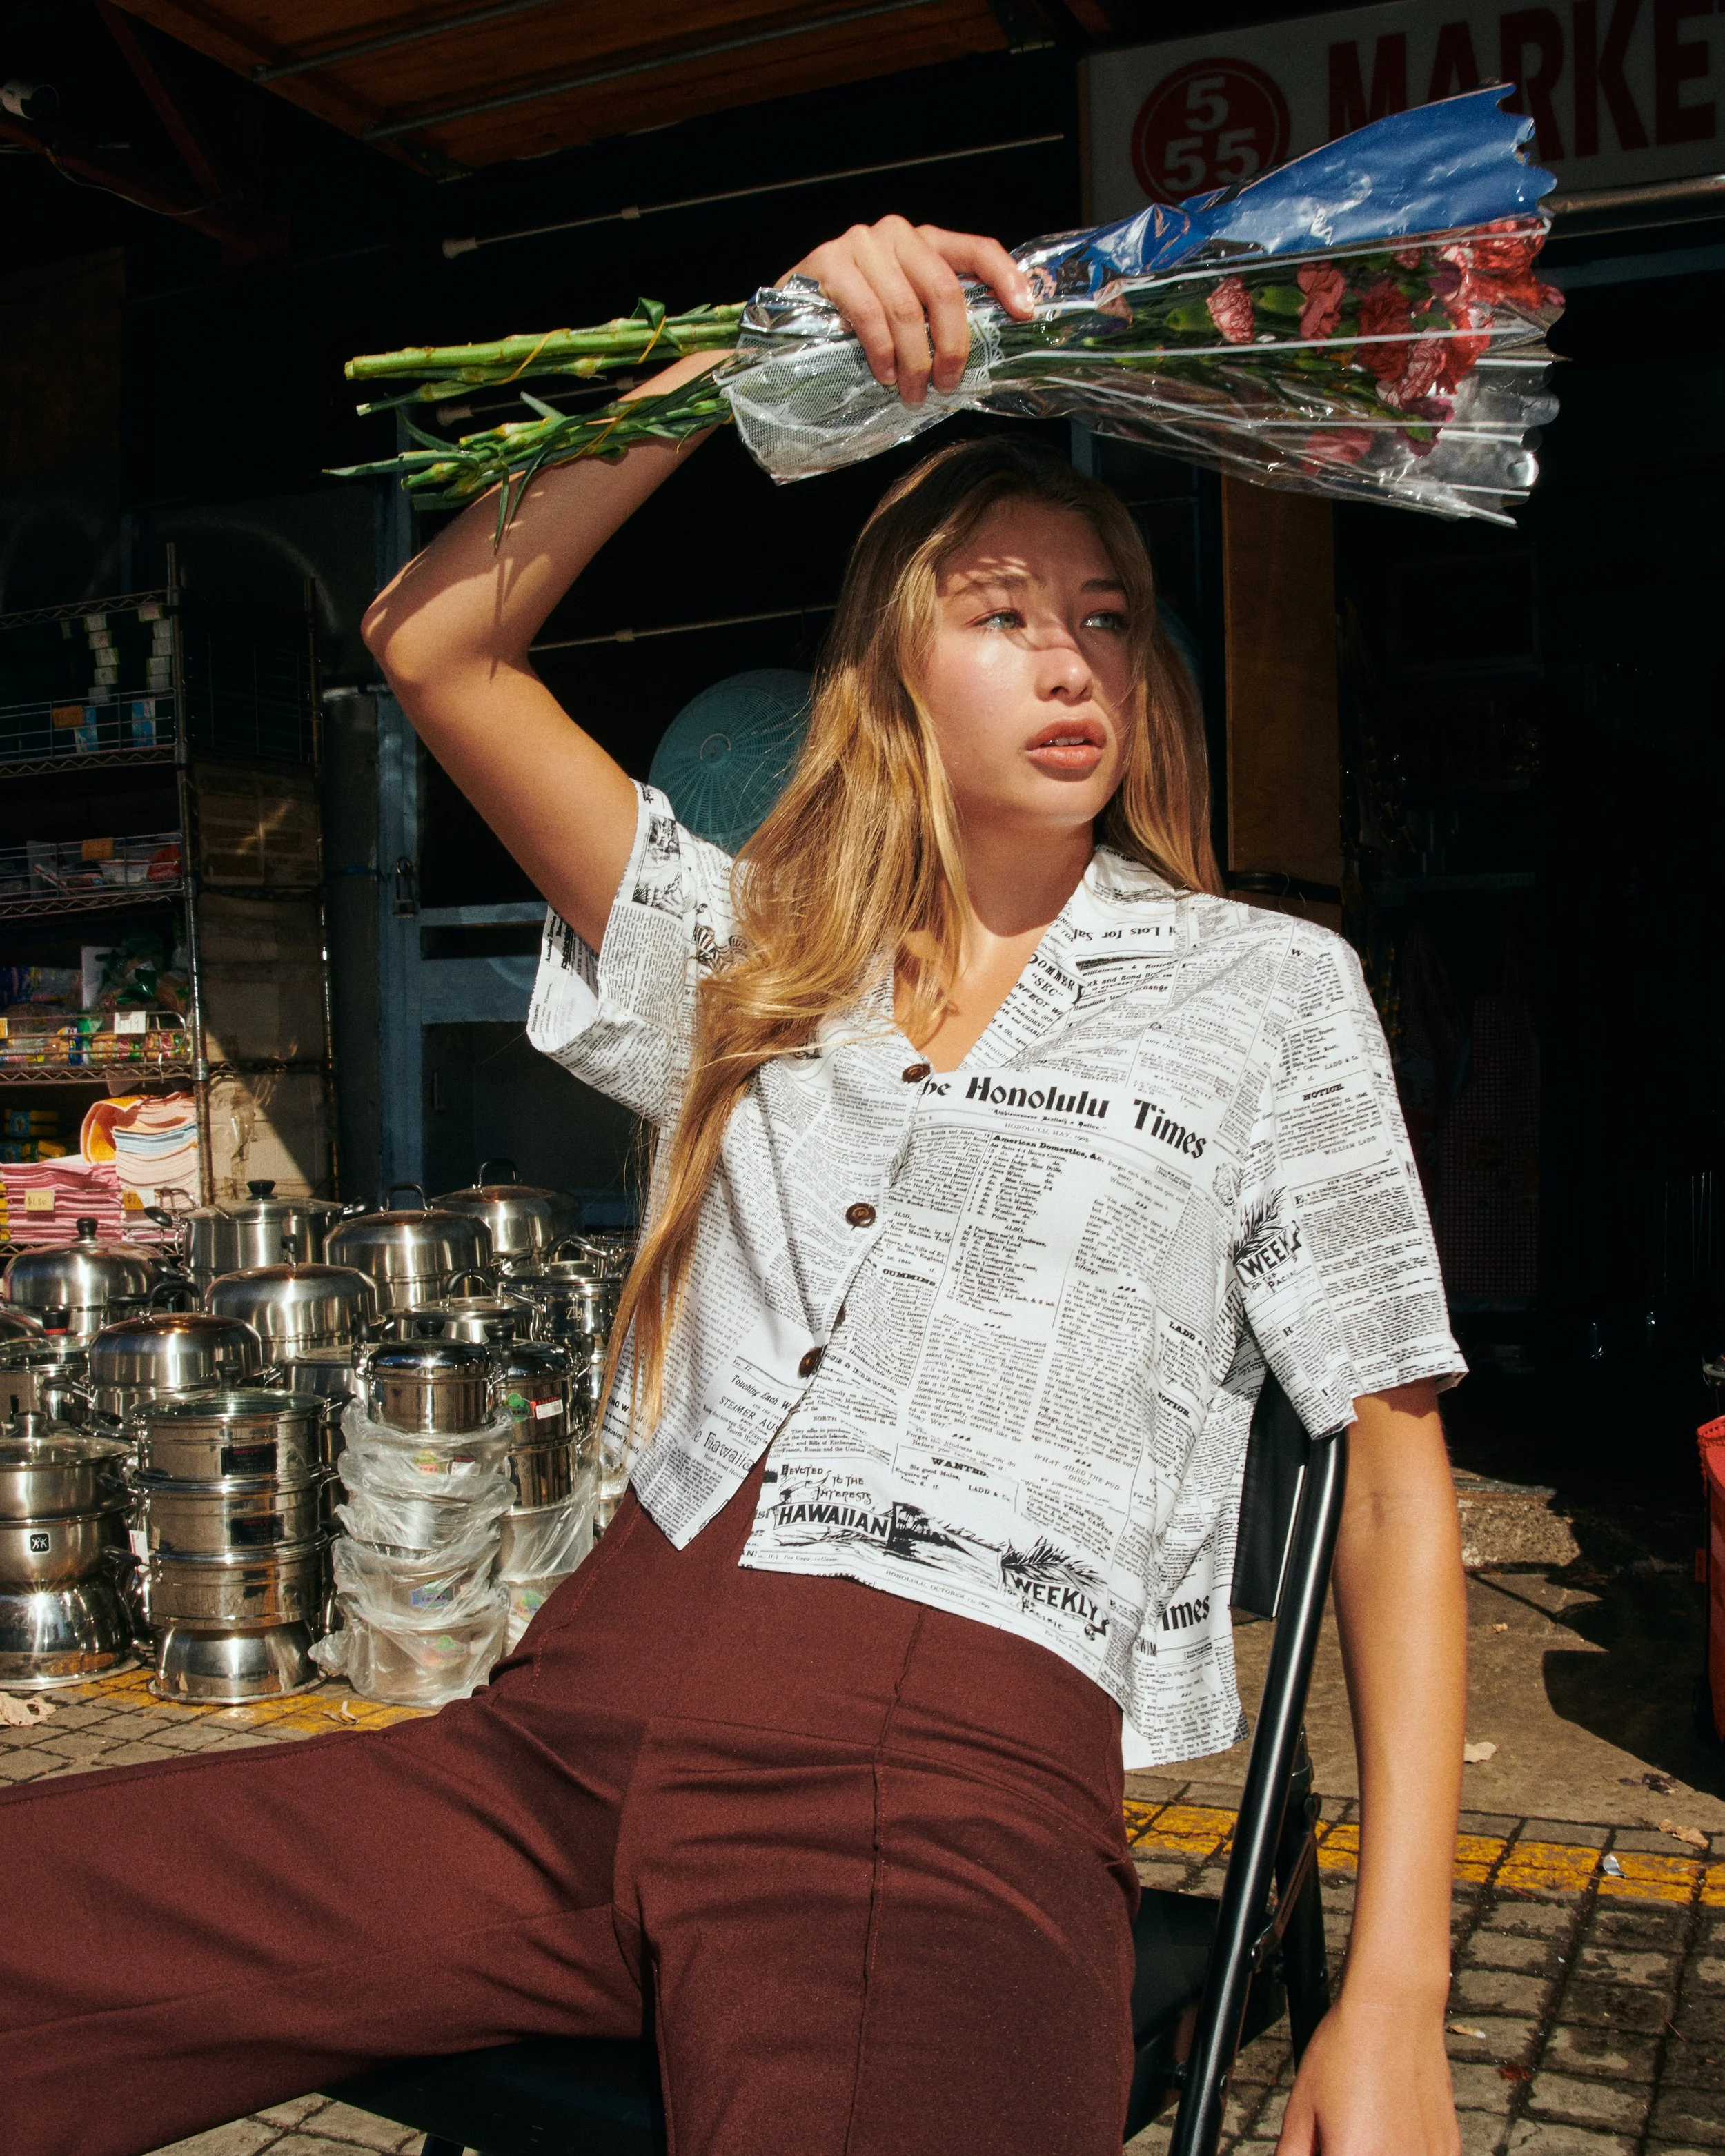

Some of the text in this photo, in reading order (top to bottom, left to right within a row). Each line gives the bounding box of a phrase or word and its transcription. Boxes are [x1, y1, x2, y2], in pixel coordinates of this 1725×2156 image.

[1328, 0, 1725, 163] MARKE
[1185, 75, 1232, 133] 5
[1161, 129, 1261, 192] 55
[1074, 927, 1094, 941] Sal
[1102, 929, 1122, 939] for
[921, 1076, 1207, 1159] he Honolulu Times
[992, 1134, 1037, 1150] American
[1039, 1142, 1087, 1160] Domestics,
[1170, 1321, 1196, 1341] LADD
[731, 1375, 779, 1405] Touching Each
[719, 1396, 756, 1420] STEAMER
[759, 1418, 780, 1434] AUS
[744, 1433, 759, 1446] Week
[781, 1465, 824, 1481] DEVOTED
[832, 1476, 865, 1487] TO THE
[931, 1456, 989, 1478] WANTED.
[1034, 1454, 1061, 1467] WHAT
[1063, 1464, 1085, 1477] AILED
[1088, 1473, 1103, 1483] THE
[968, 1485, 990, 1495] LADD
[778, 1504, 889, 1538] HAWAIIAN
[1012, 1574, 1098, 1621] WEEKLY
[1162, 1595, 1210, 1631] imes
